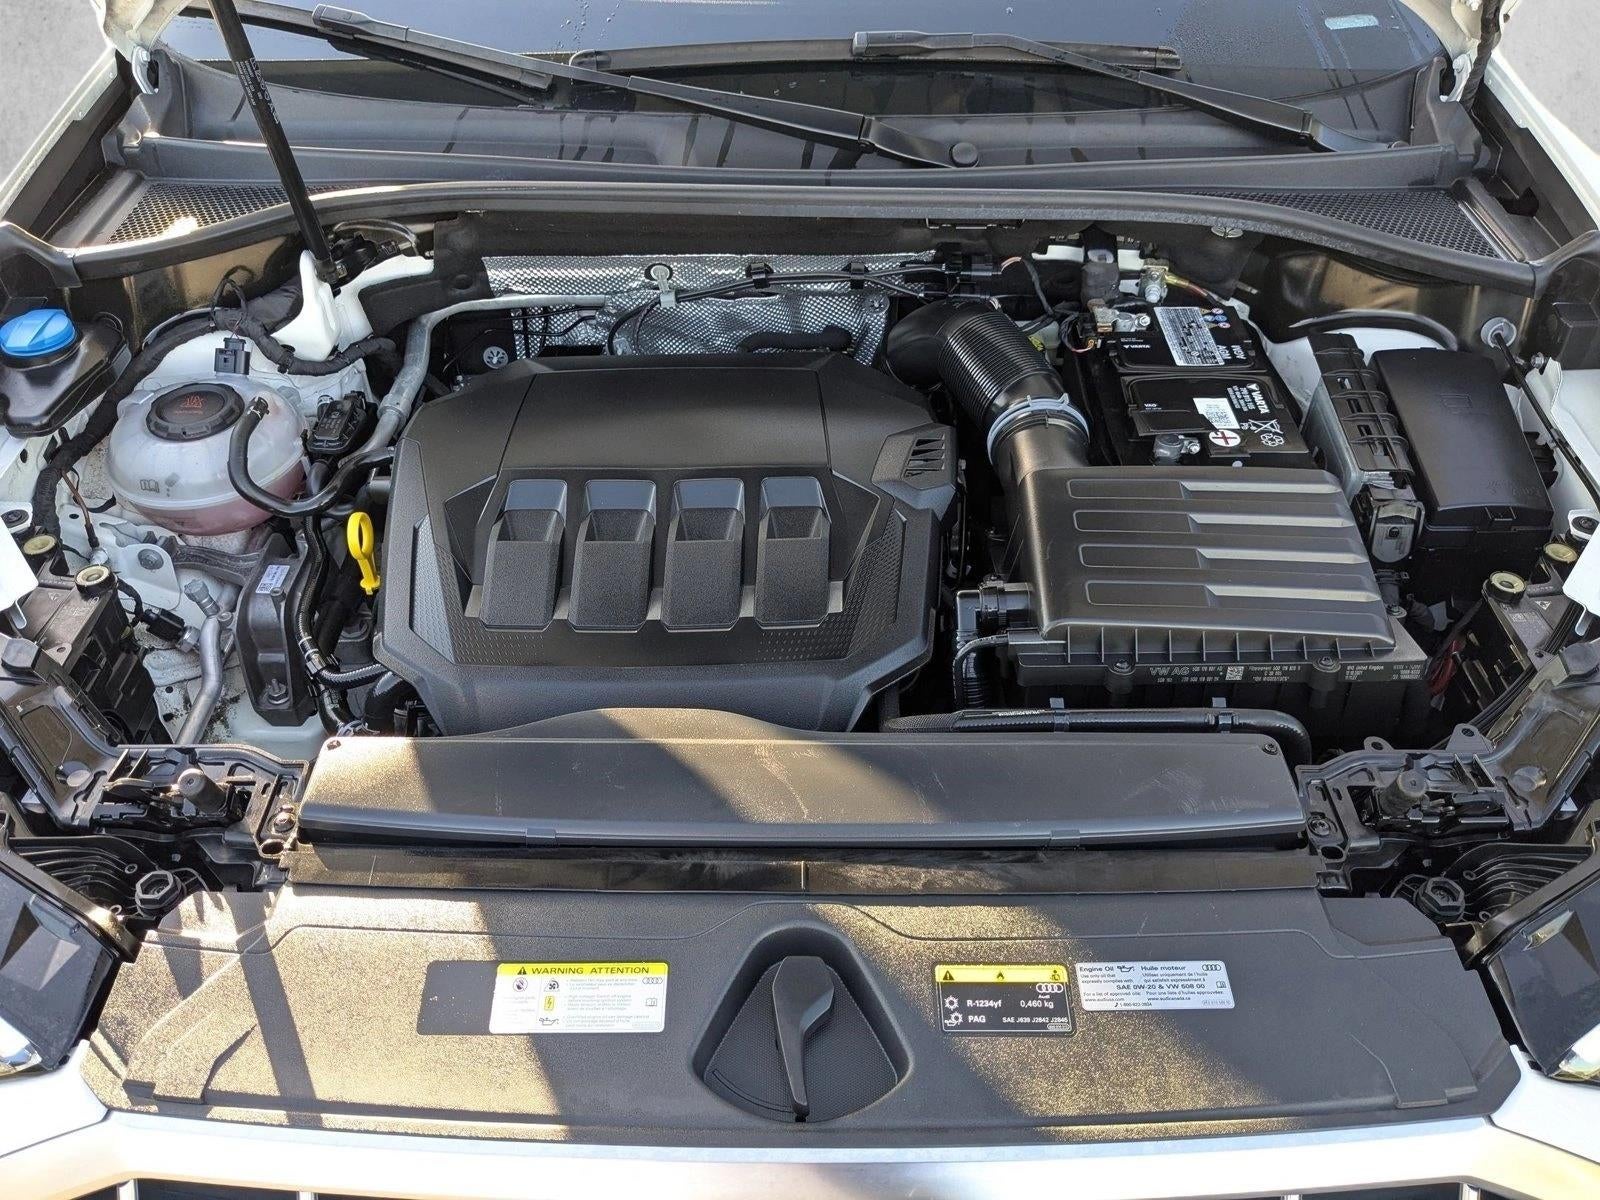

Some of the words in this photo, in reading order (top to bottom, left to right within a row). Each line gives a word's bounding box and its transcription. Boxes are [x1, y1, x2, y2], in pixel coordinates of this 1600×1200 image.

[1252, 391, 1270, 414] VARTA
[532, 967, 584, 975] WARNING
[590, 966, 650, 974] ATTENTION
[967, 999, 1002, 1009] R-1234yf
[1020, 1000, 1042, 1008] 0,460
[1044, 1000, 1054, 1009] kg
